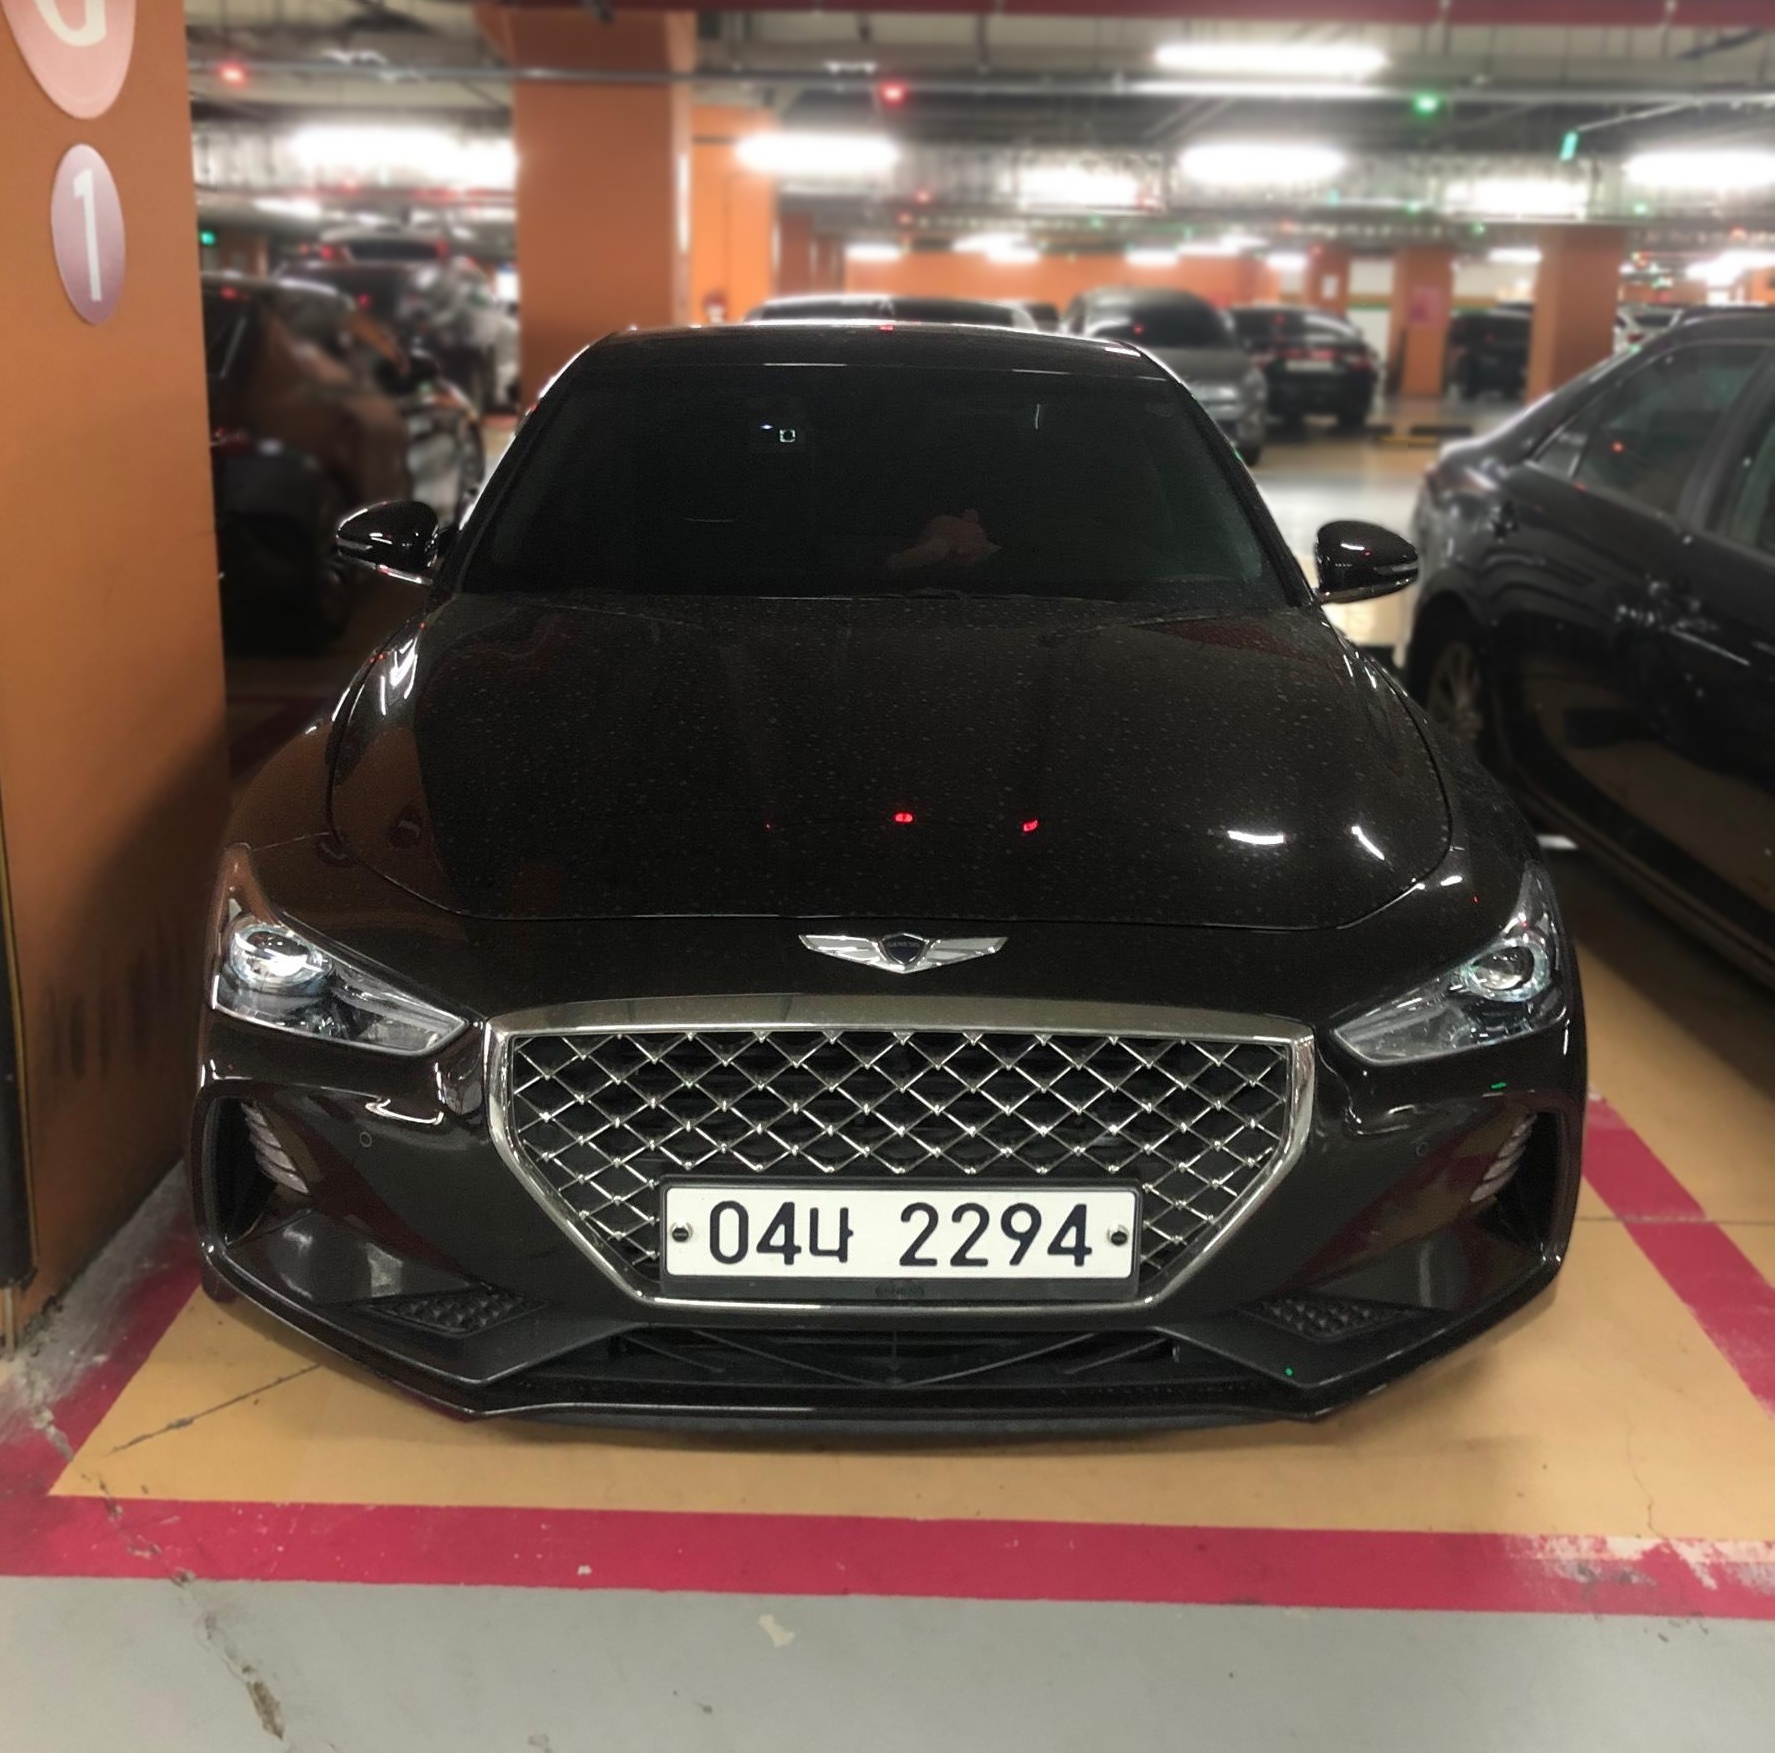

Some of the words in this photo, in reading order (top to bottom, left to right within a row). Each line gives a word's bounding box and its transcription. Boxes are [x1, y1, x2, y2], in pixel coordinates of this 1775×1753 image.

[73, 169, 102, 302] 1
[709, 1200, 854, 1265] 04나
[899, 1202, 1093, 1267] 2294
